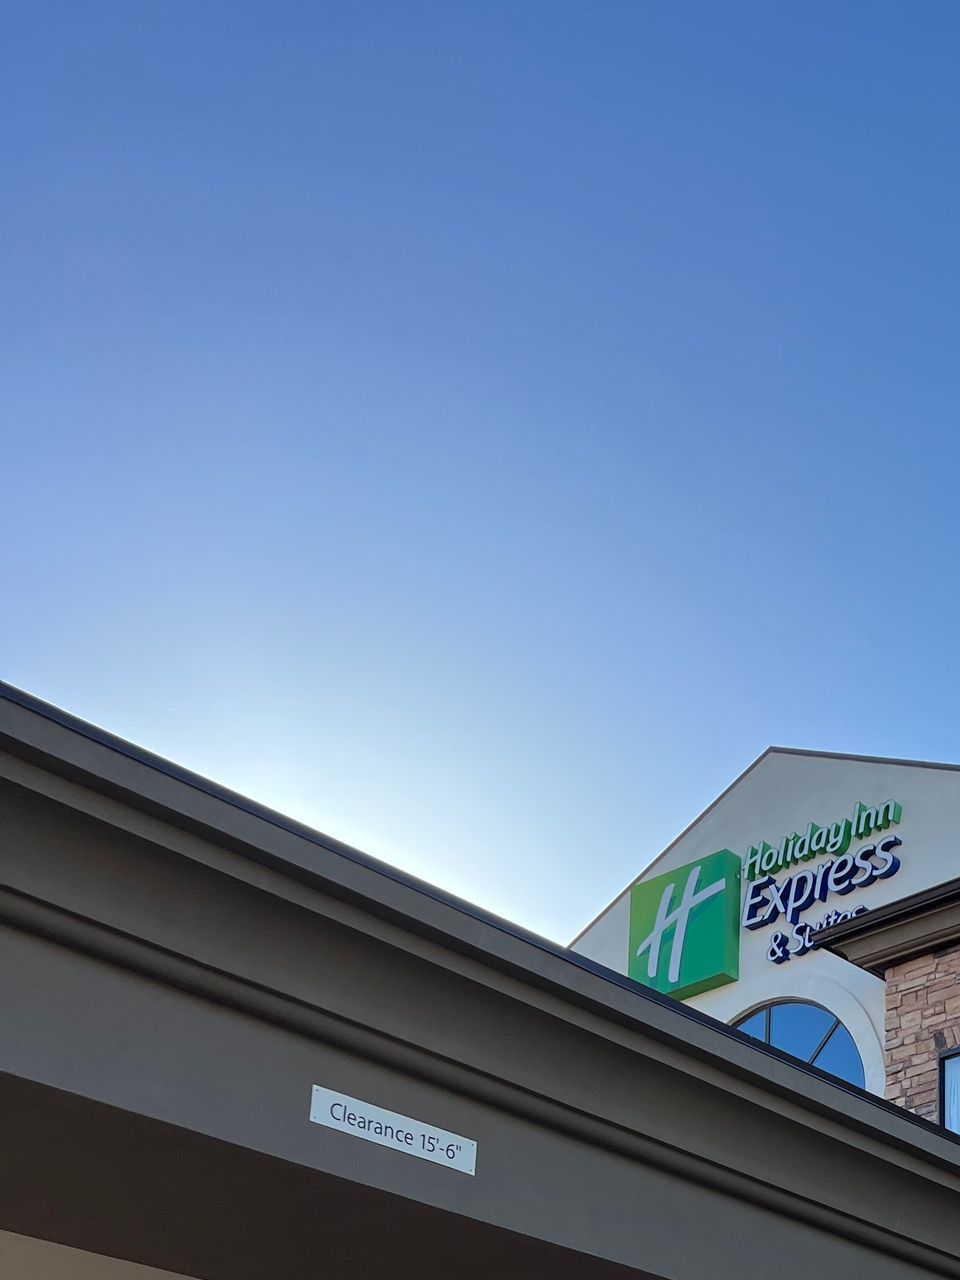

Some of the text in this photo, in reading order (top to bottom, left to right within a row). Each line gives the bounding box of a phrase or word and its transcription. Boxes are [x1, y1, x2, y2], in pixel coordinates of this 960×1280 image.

[742, 799, 902, 882] Holiday Inn
[741, 834, 902, 931] Express
[767, 931, 790, 965] &
[330, 1102, 462, 1160] Clearance 15'-6"
